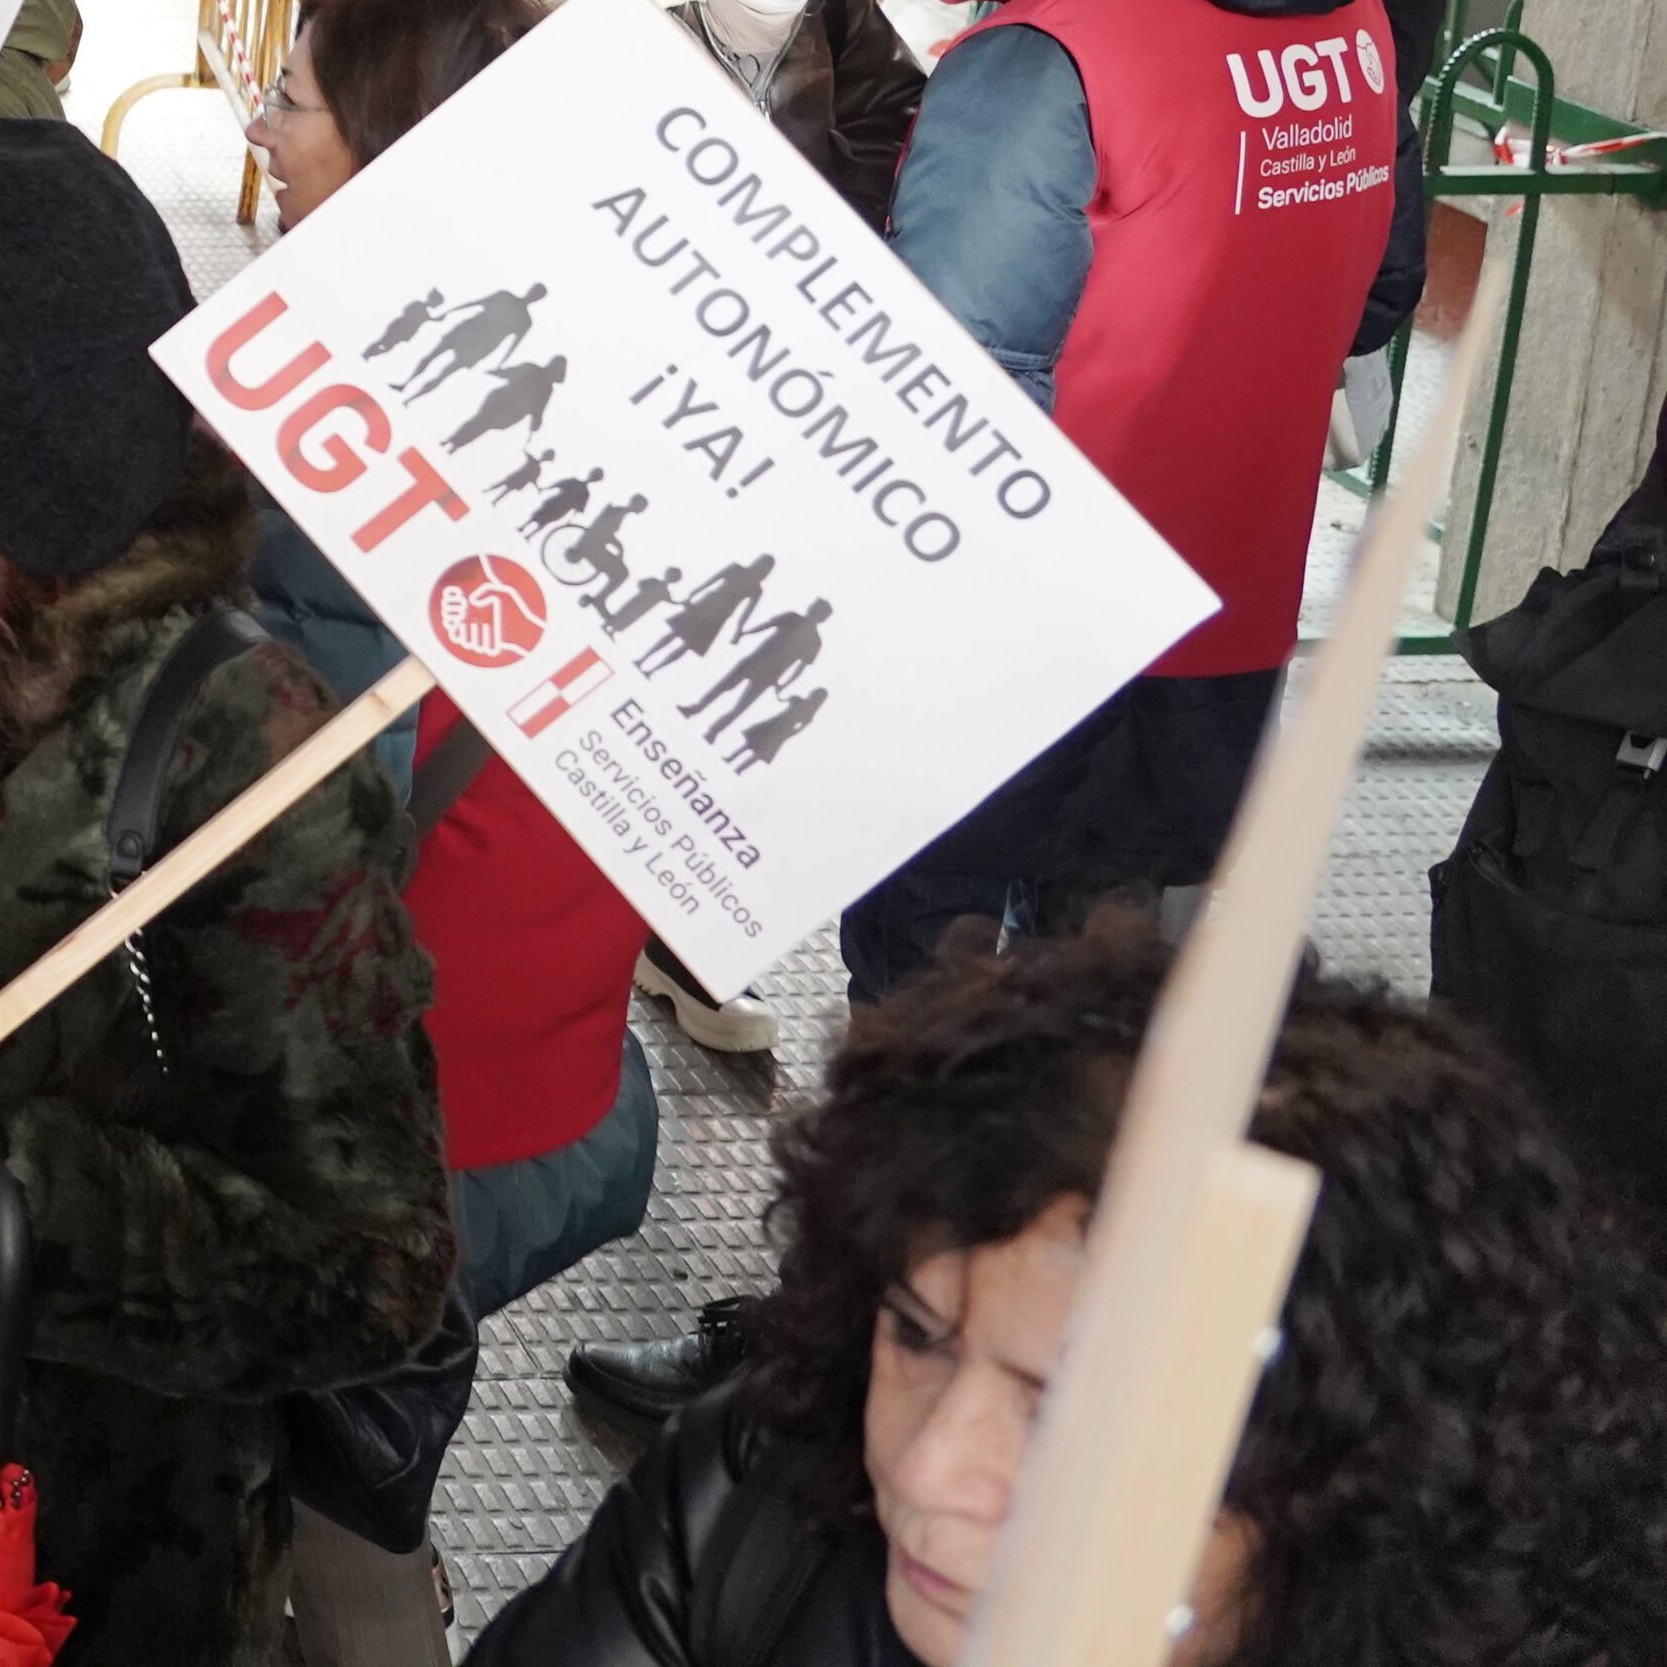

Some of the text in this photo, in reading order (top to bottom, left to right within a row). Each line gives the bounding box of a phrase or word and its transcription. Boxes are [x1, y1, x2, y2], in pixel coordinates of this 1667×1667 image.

[1226, 36, 1354, 119] UGT
[1260, 145, 1356, 176] Castilla y León
[1262, 113, 1353, 151] Valladolid
[1258, 163, 1389, 210] Servicios Públicos
[590, 184, 962, 566] AUTONÓMICO
[653, 102, 1053, 523] COMPLEMENTO
[203, 290, 472, 556] UGT
[629, 362, 777, 502] ¡YA!
[554, 749, 704, 917] Castilla y León
[577, 729, 766, 940] Servicios Públicos
[611, 698, 763, 870] Enseñanza
